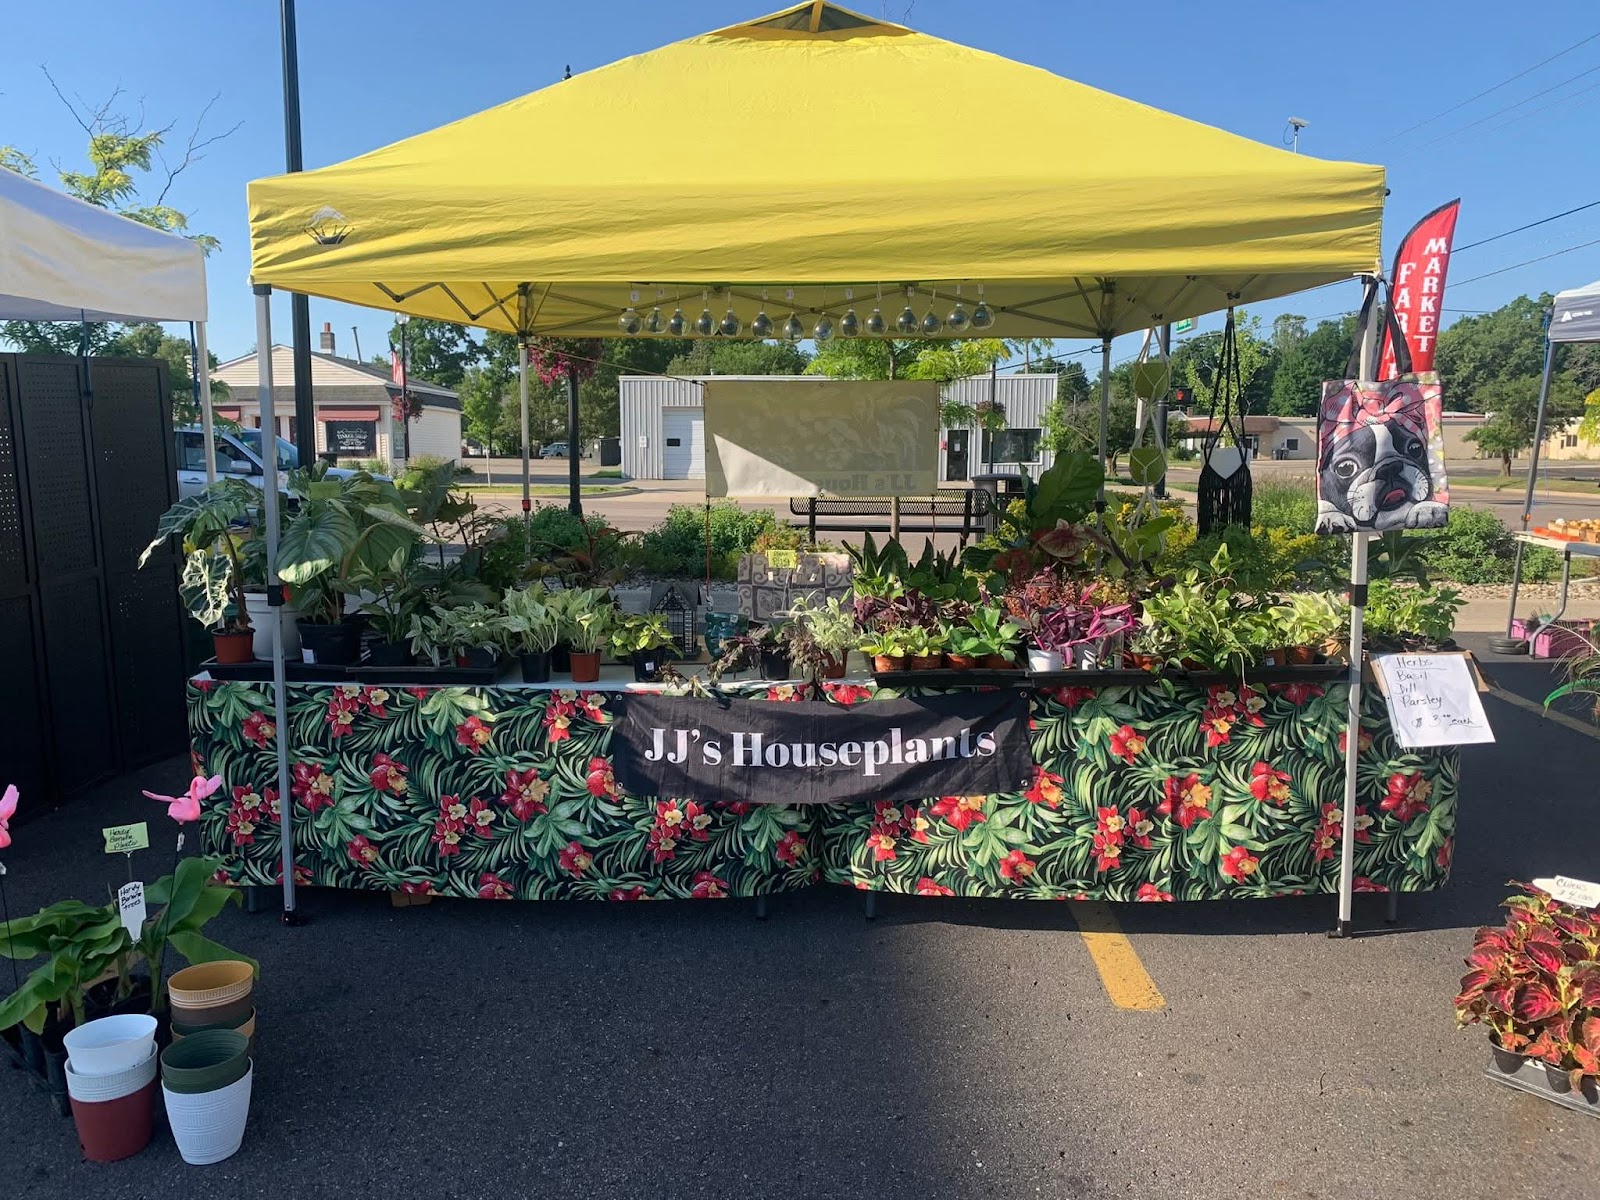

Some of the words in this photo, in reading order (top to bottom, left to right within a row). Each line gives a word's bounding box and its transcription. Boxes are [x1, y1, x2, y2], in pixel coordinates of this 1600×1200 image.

[1413, 237, 1448, 353] MARKET
[1396, 656, 1433, 668] Herbs
[1396, 670, 1429, 681] Basil
[1394, 683, 1417, 695] Dill
[1400, 694, 1442, 709] Parsley
[1451, 717, 1475, 726] each
[644, 727, 722, 767] JJ's
[731, 727, 998, 777] Houseplants
[120, 884, 141, 897] Hardy
